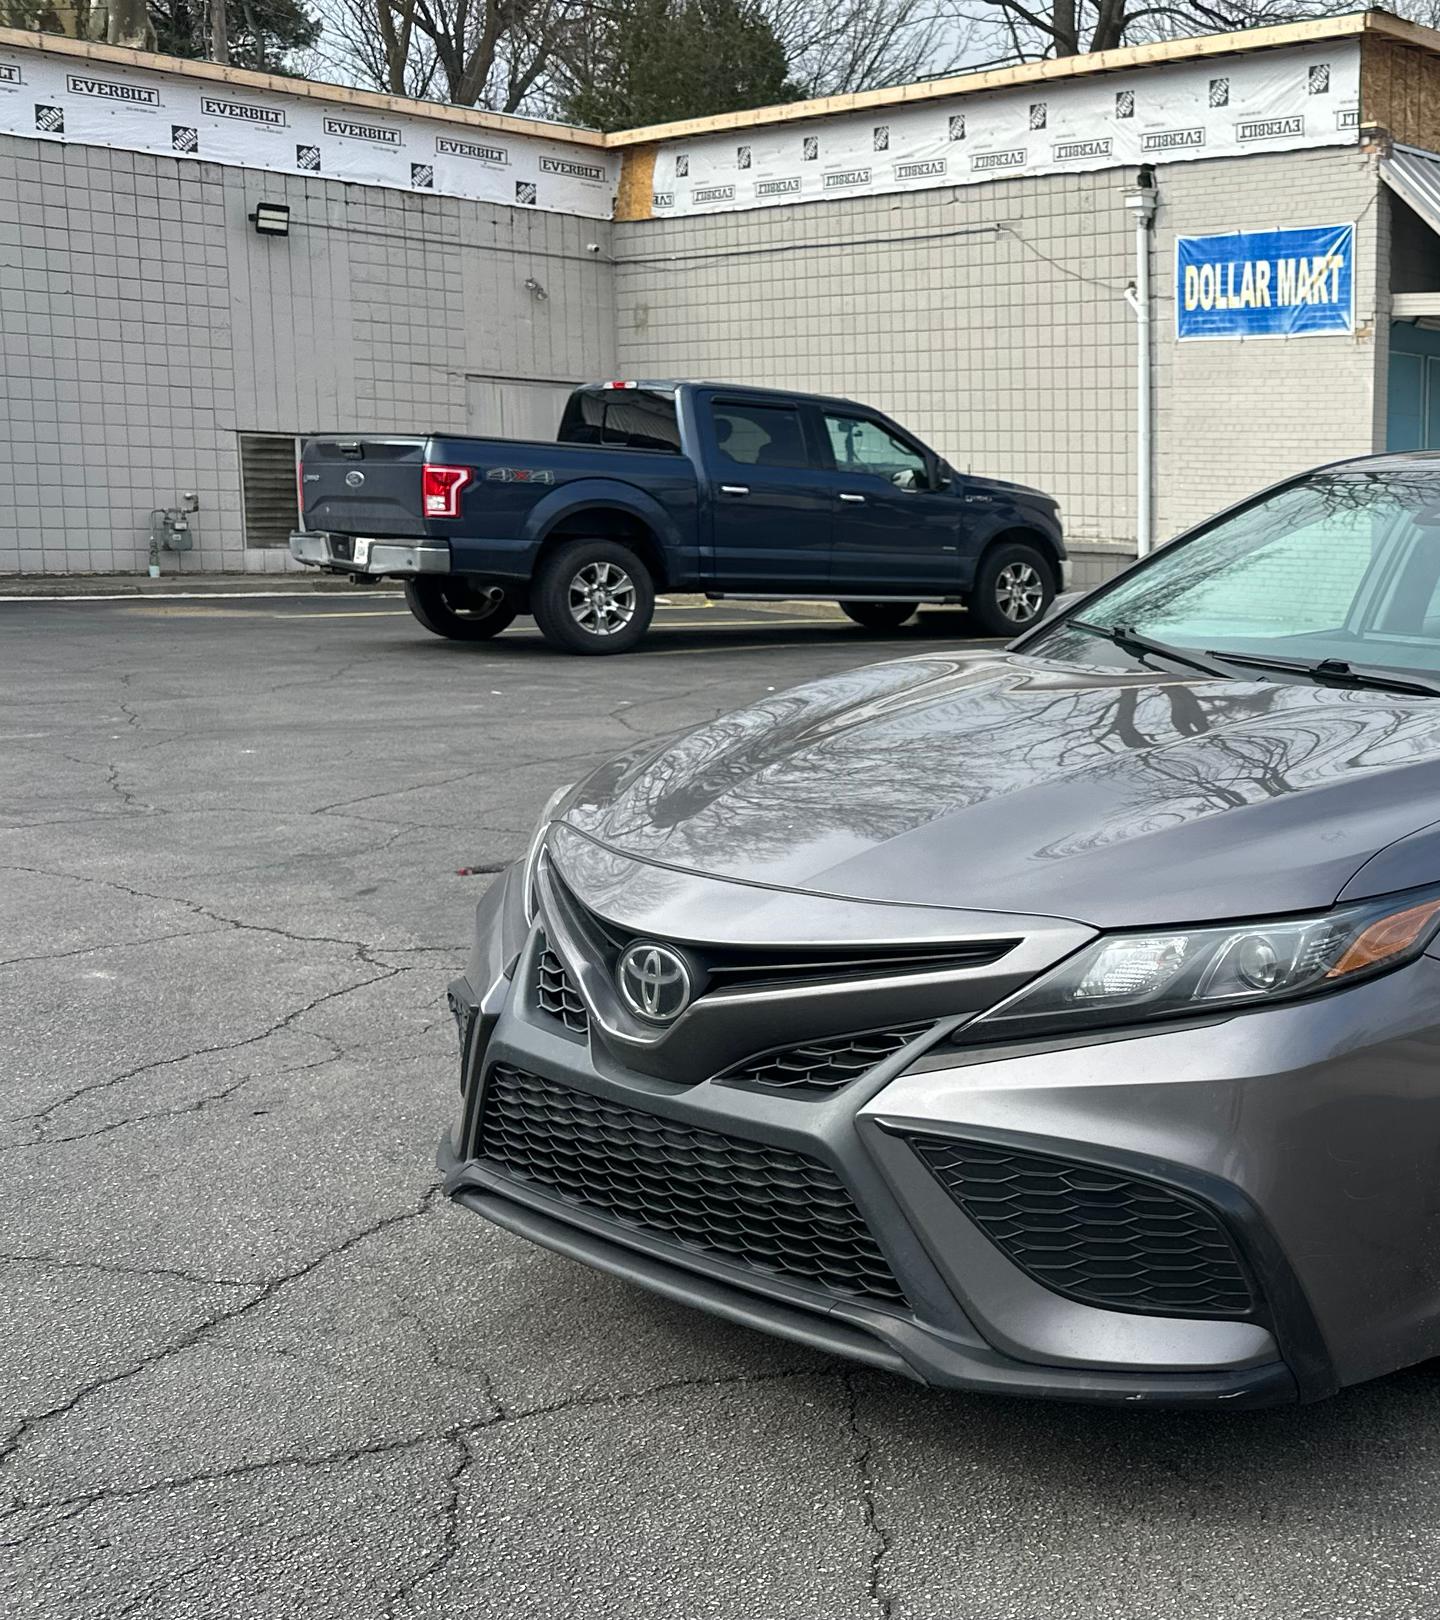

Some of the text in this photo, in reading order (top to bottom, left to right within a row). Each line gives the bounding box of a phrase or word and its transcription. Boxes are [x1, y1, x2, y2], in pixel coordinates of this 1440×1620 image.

[71, 79, 156, 103] EVERBILT
[36, 107, 64, 131] HOME
[205, 101, 282, 123] EVERBILT
[327, 121, 398, 143] EVERBILT
[1240, 118, 1301, 139] EVERBILT
[1056, 140, 1110, 159] EVERBILT
[1144, 130, 1202, 149] EVERBILT
[439, 141, 505, 162] EVERBILT
[974, 151, 1025, 169] EVERBILT
[543, 160, 602, 179] EVERBILT
[825, 171, 870, 187] EVERBILT
[897, 161, 945, 178] EVERBILT
[1185, 254, 1344, 311] DOLLAR MART
